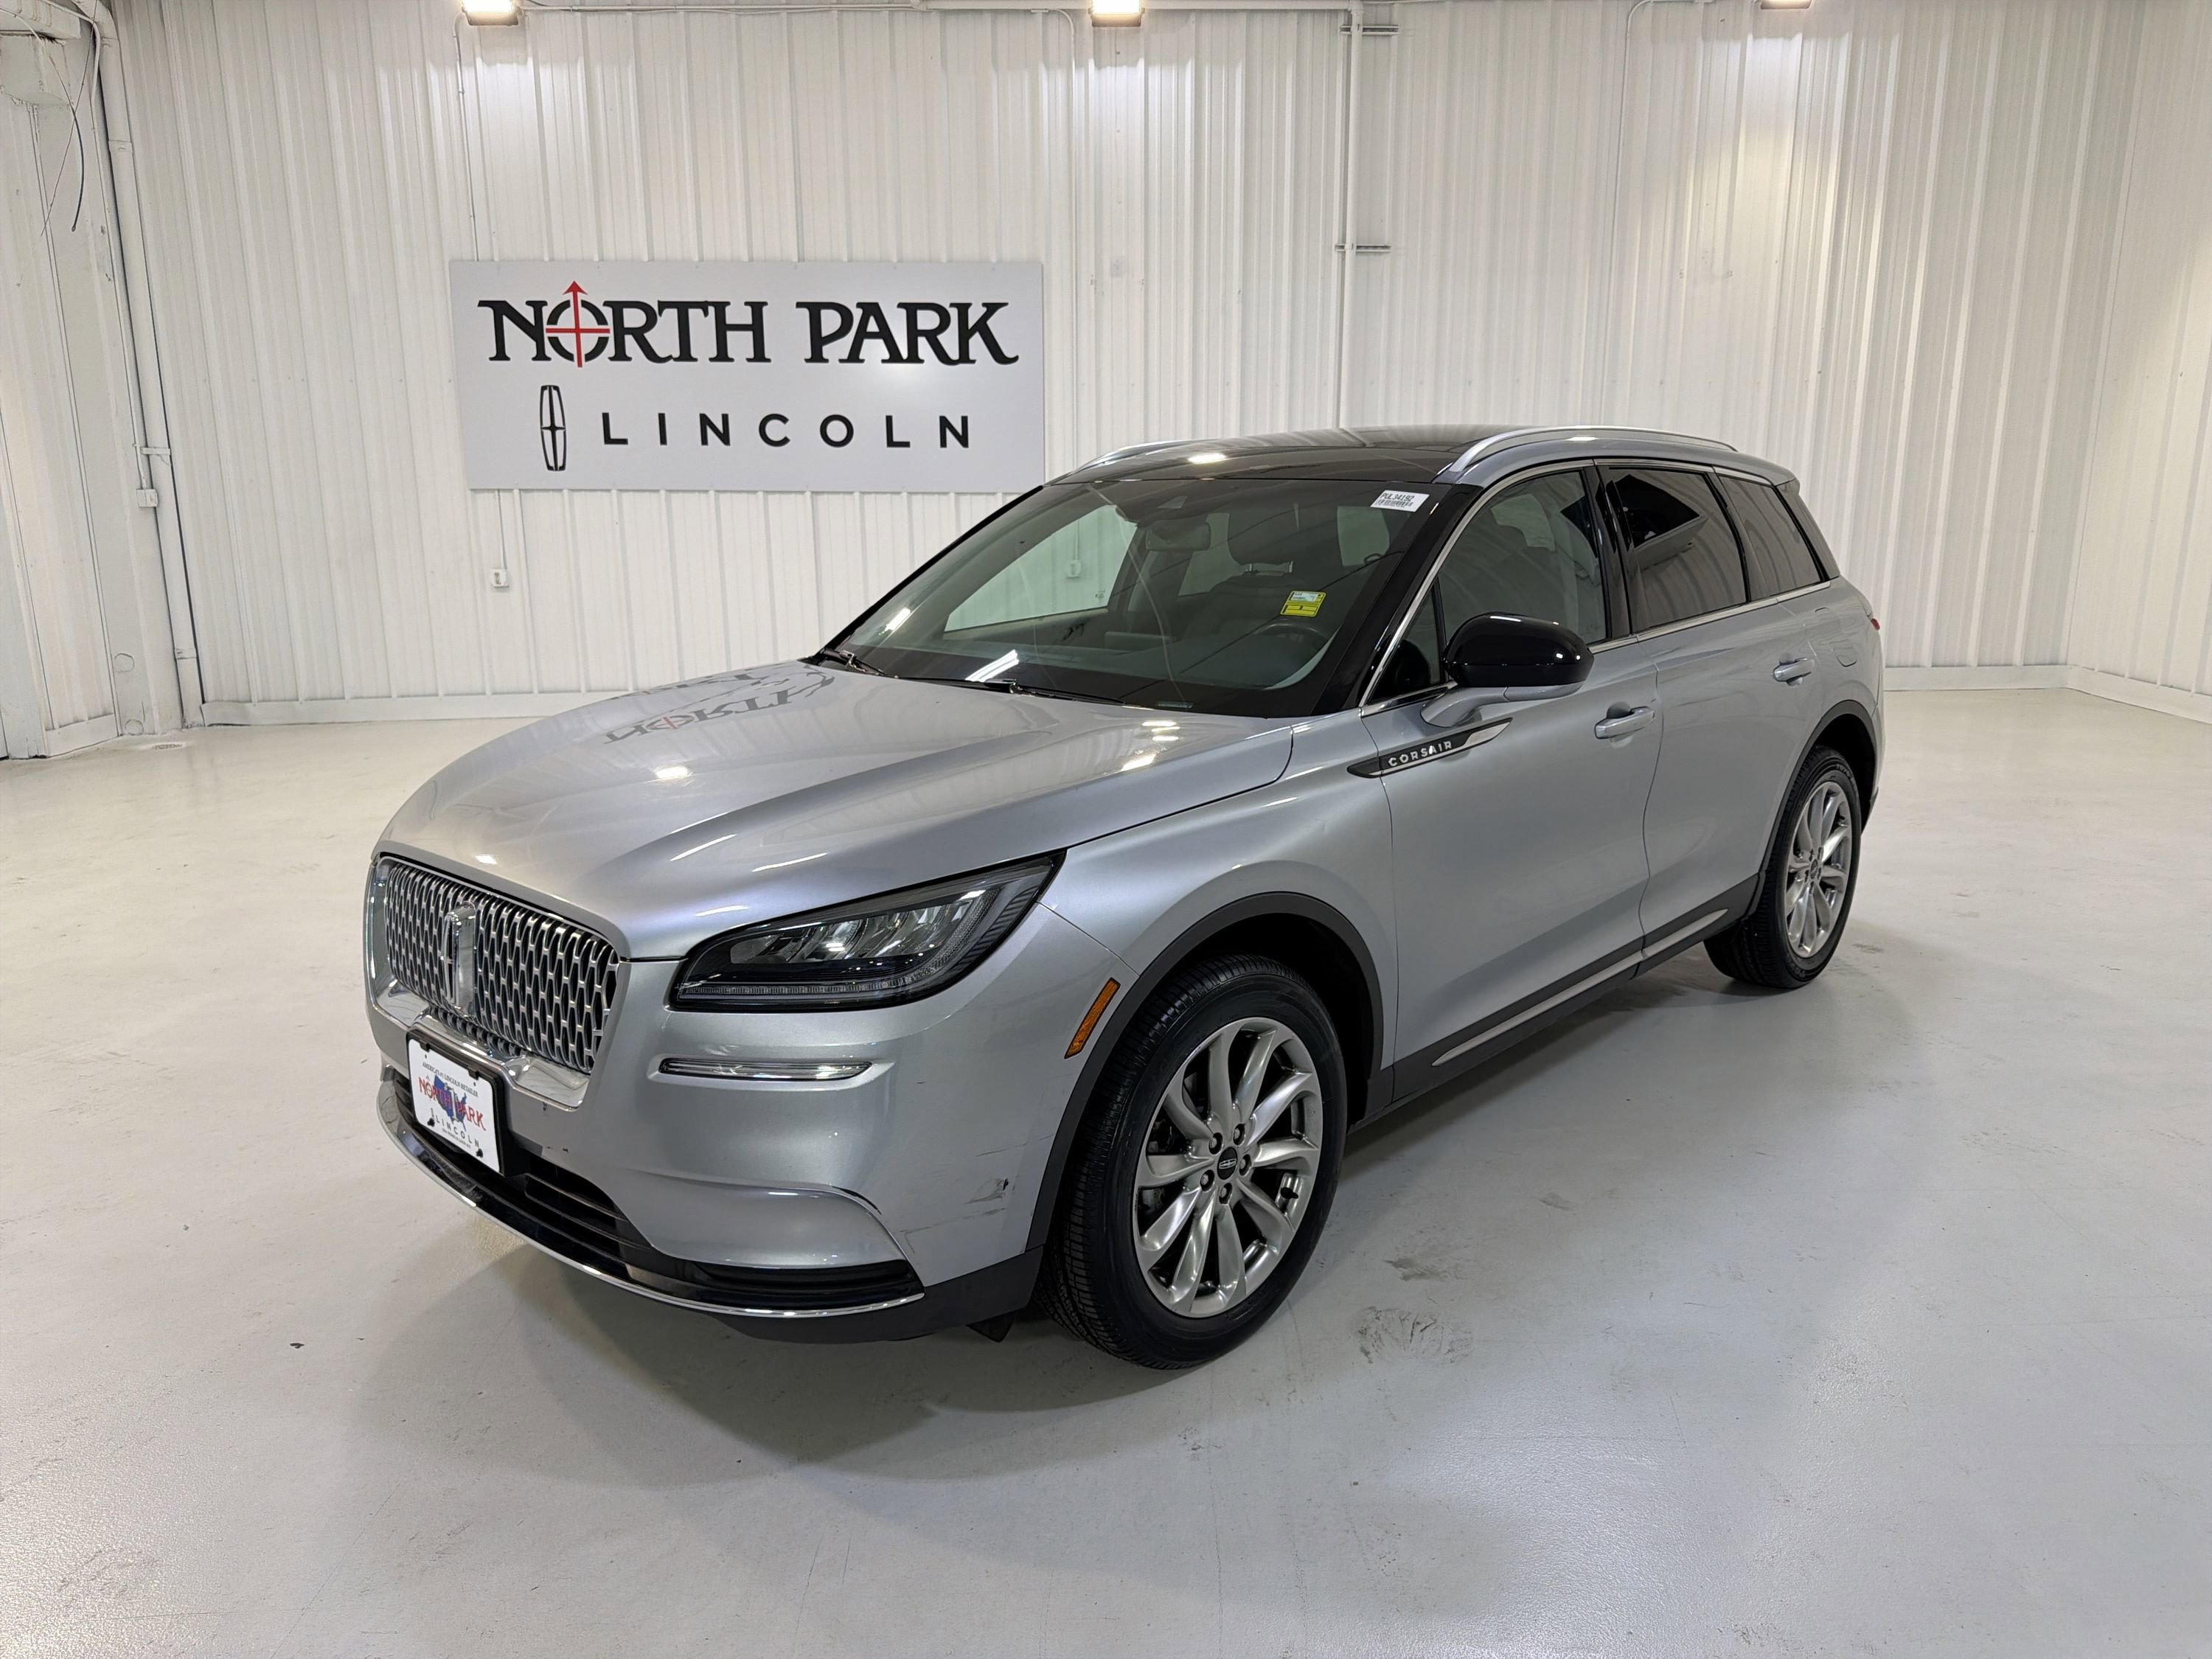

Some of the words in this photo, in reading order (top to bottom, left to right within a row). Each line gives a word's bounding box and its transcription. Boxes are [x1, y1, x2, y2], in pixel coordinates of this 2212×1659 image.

[478, 299, 771, 364] NORTH
[796, 301, 1019, 366] PARK
[602, 412, 969, 448] LINCOLN
[1388, 740, 1453, 767] CORSAIR
[444, 1073, 461, 1088] LINCOLN
[461, 1082, 479, 1097] RETAILER
[418, 1077, 451, 1107] NORTH
[454, 1099, 487, 1131] PARK
[436, 1114, 480, 1148] LINCOLN
